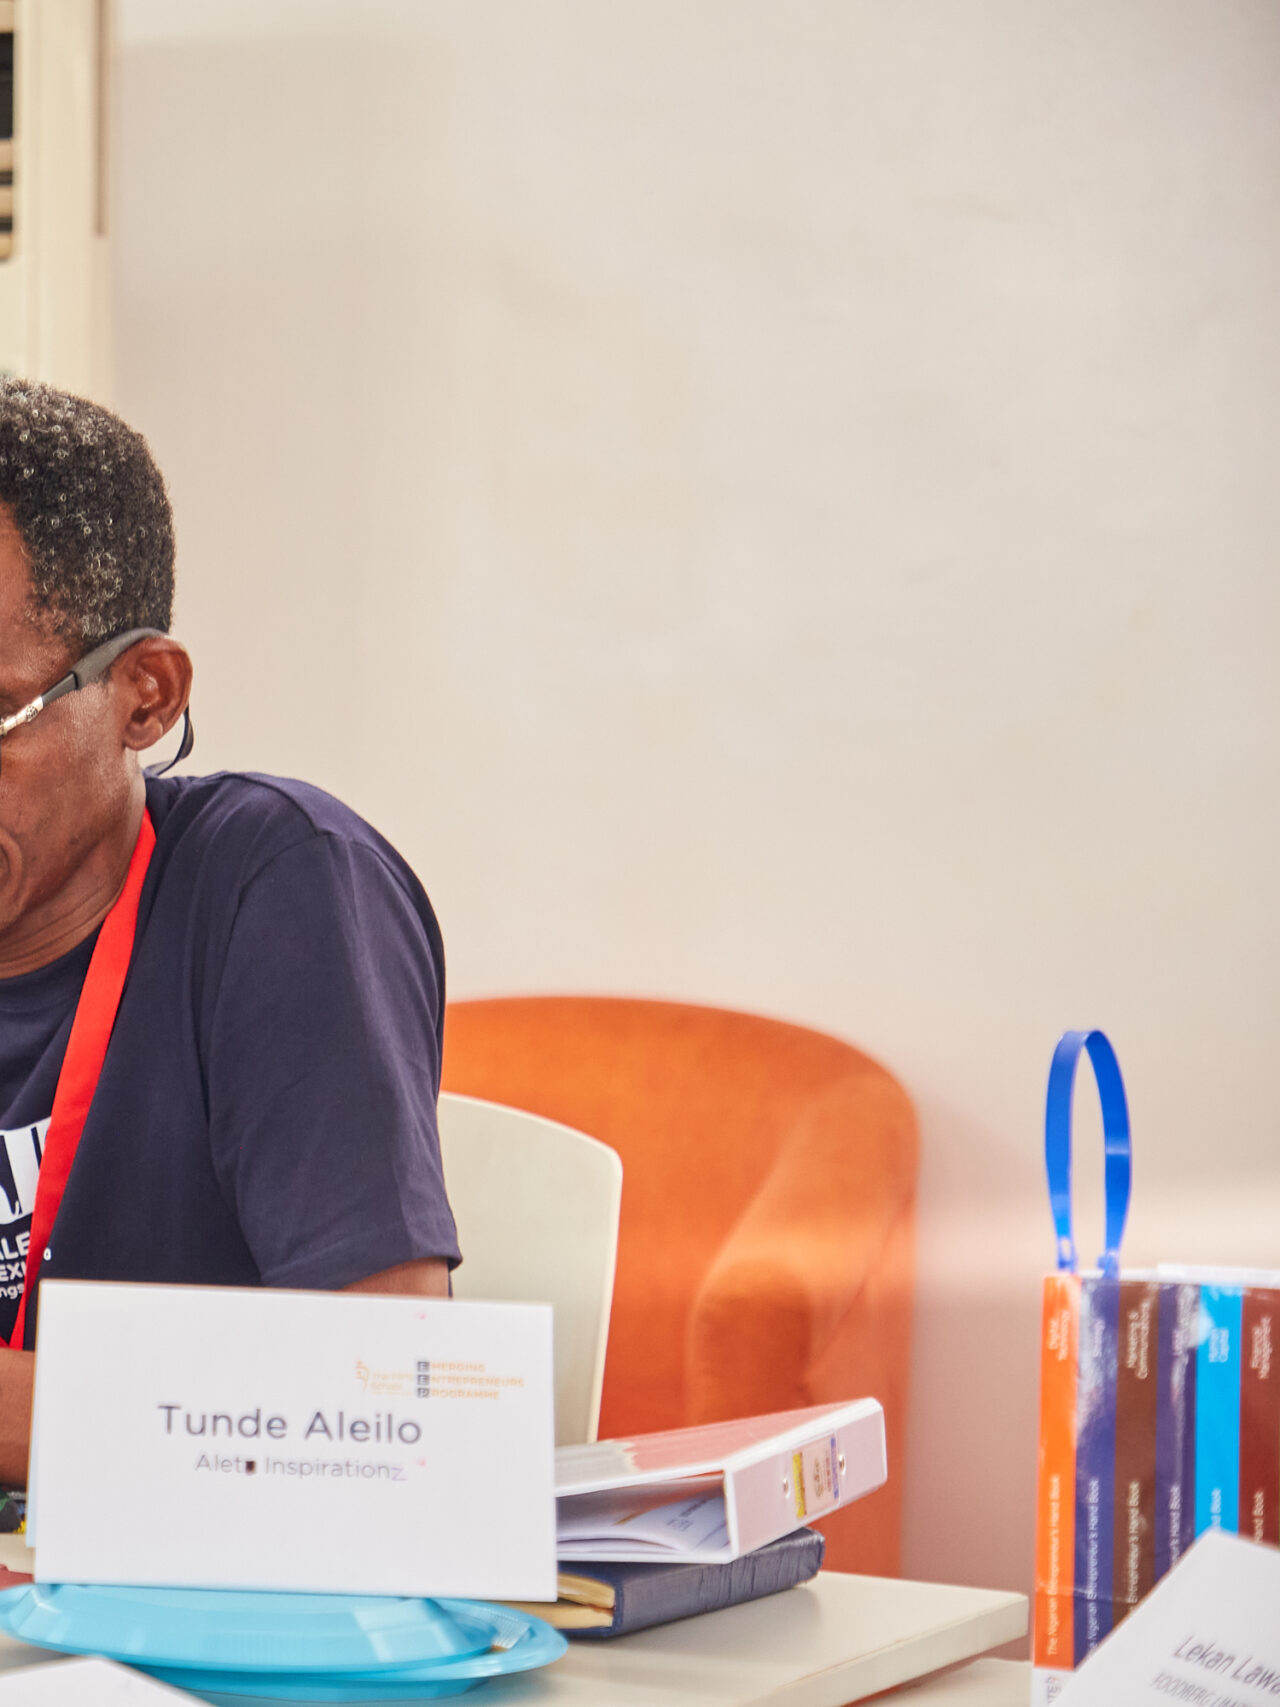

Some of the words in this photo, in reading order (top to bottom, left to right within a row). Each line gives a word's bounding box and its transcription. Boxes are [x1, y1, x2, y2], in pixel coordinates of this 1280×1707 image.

[157, 1404, 287, 1440] Tunde
[304, 1410, 422, 1445] Aleilo
[195, 1453, 256, 1475] Alet
[1087, 1478, 1100, 1504] Book
[1049, 1501, 1060, 1528] Hand
[1088, 1505, 1099, 1531] Hand
[1047, 1638, 1058, 1656] The
[1172, 1635, 1236, 1674] Lekan
